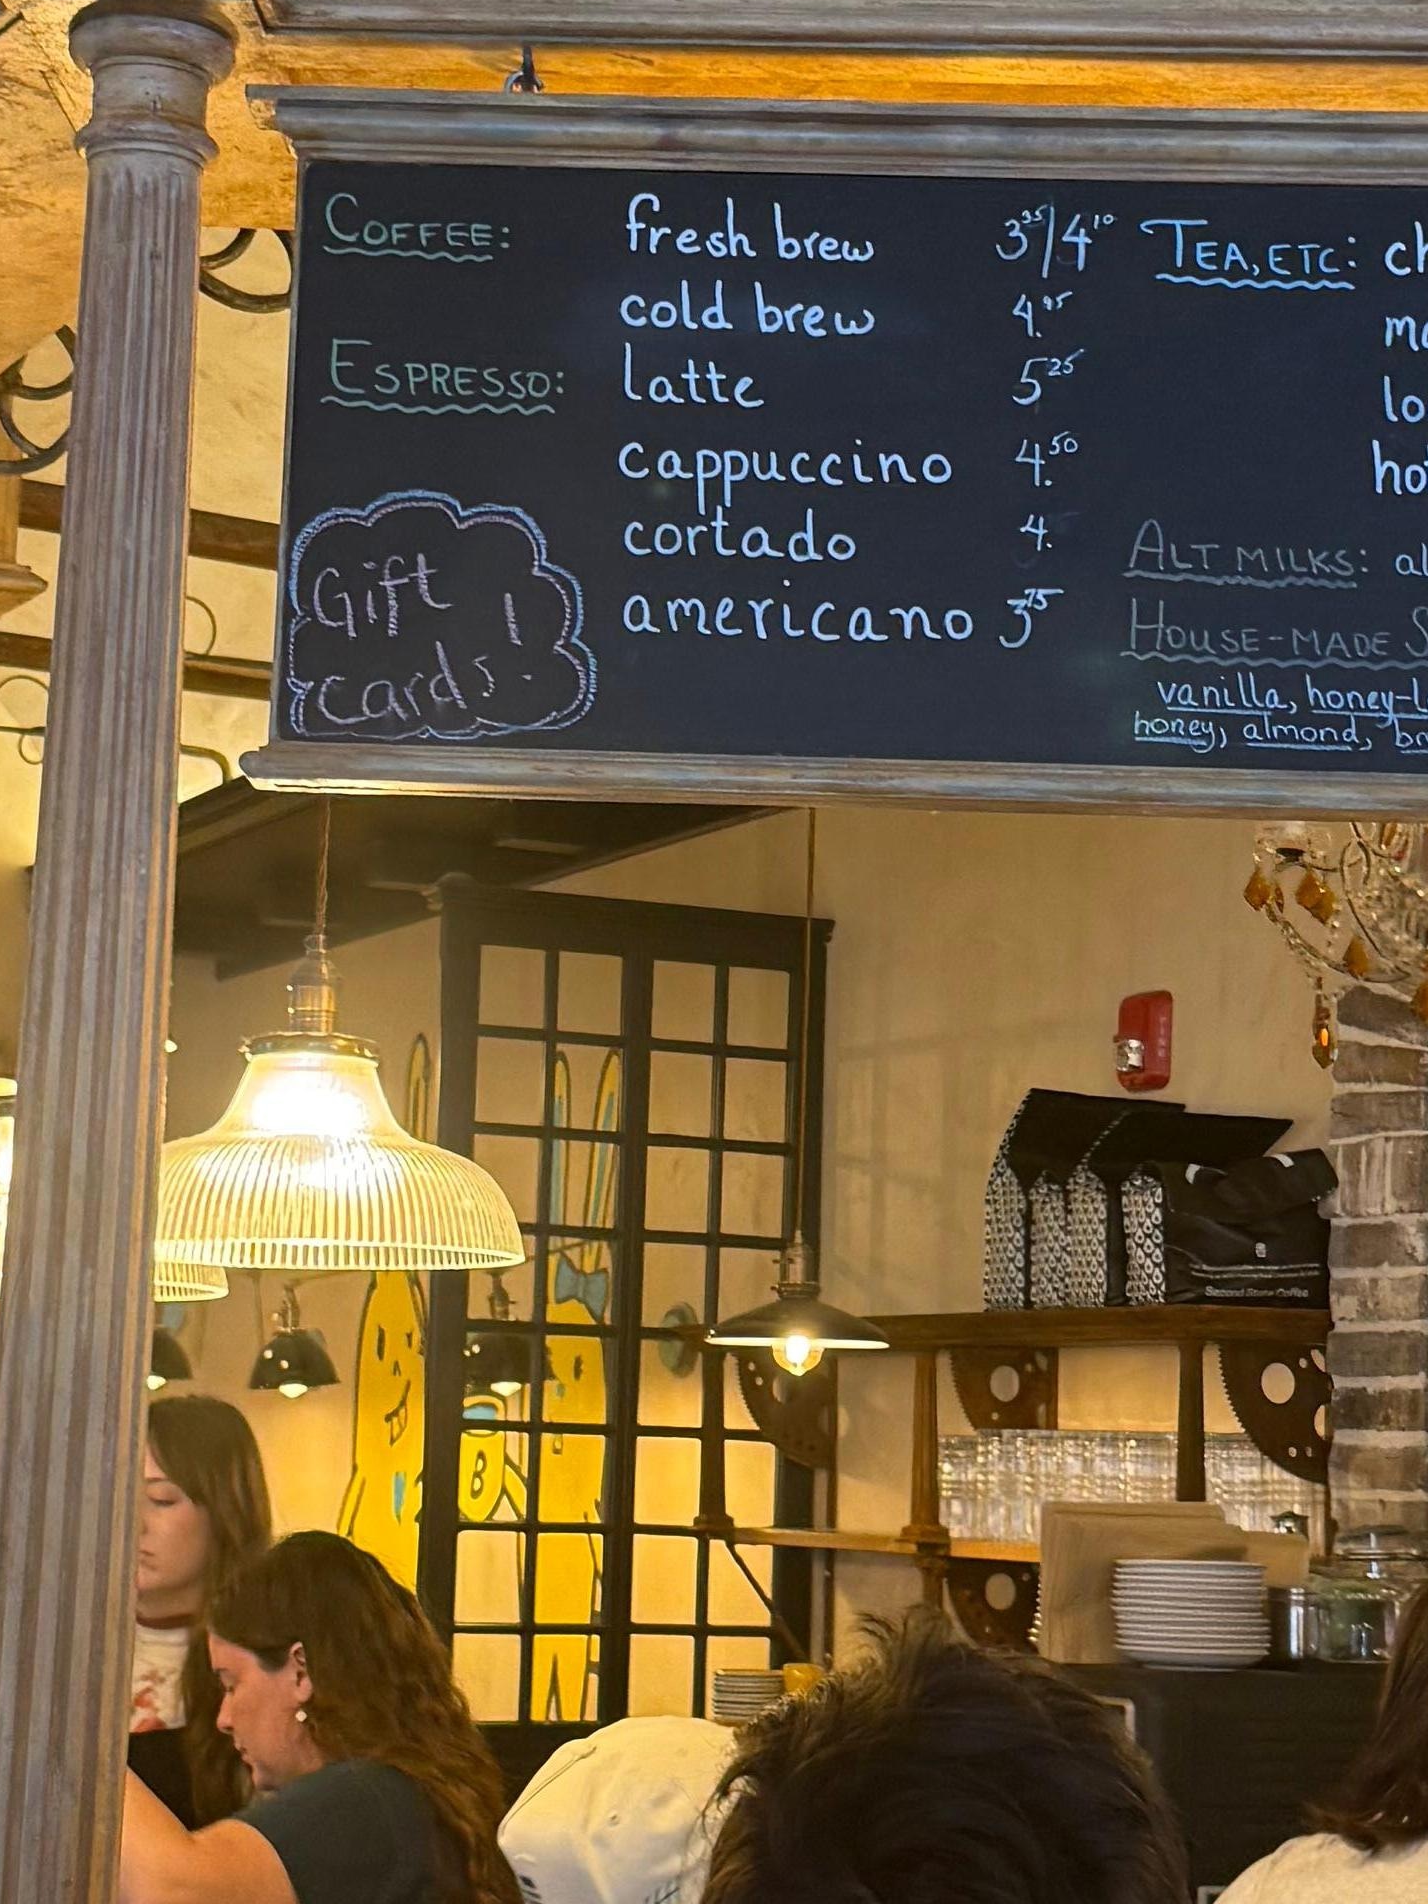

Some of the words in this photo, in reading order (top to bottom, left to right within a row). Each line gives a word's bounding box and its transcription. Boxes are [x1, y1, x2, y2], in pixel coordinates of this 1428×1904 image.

[626, 193, 756, 259] fresh
[774, 202, 874, 263] brew
[619, 280, 733, 332] cold
[755, 280, 875, 338] brew
[623, 342, 765, 409] latte
[618, 439, 953, 516] cappuccino
[624, 507, 857, 563] cortado
[313, 552, 453, 640] Gift
[623, 579, 974, 643] americano
[1157, 672, 1298, 713] vanilla,
[1134, 710, 1228, 754] honey,
[1243, 714, 1373, 751] almond,
